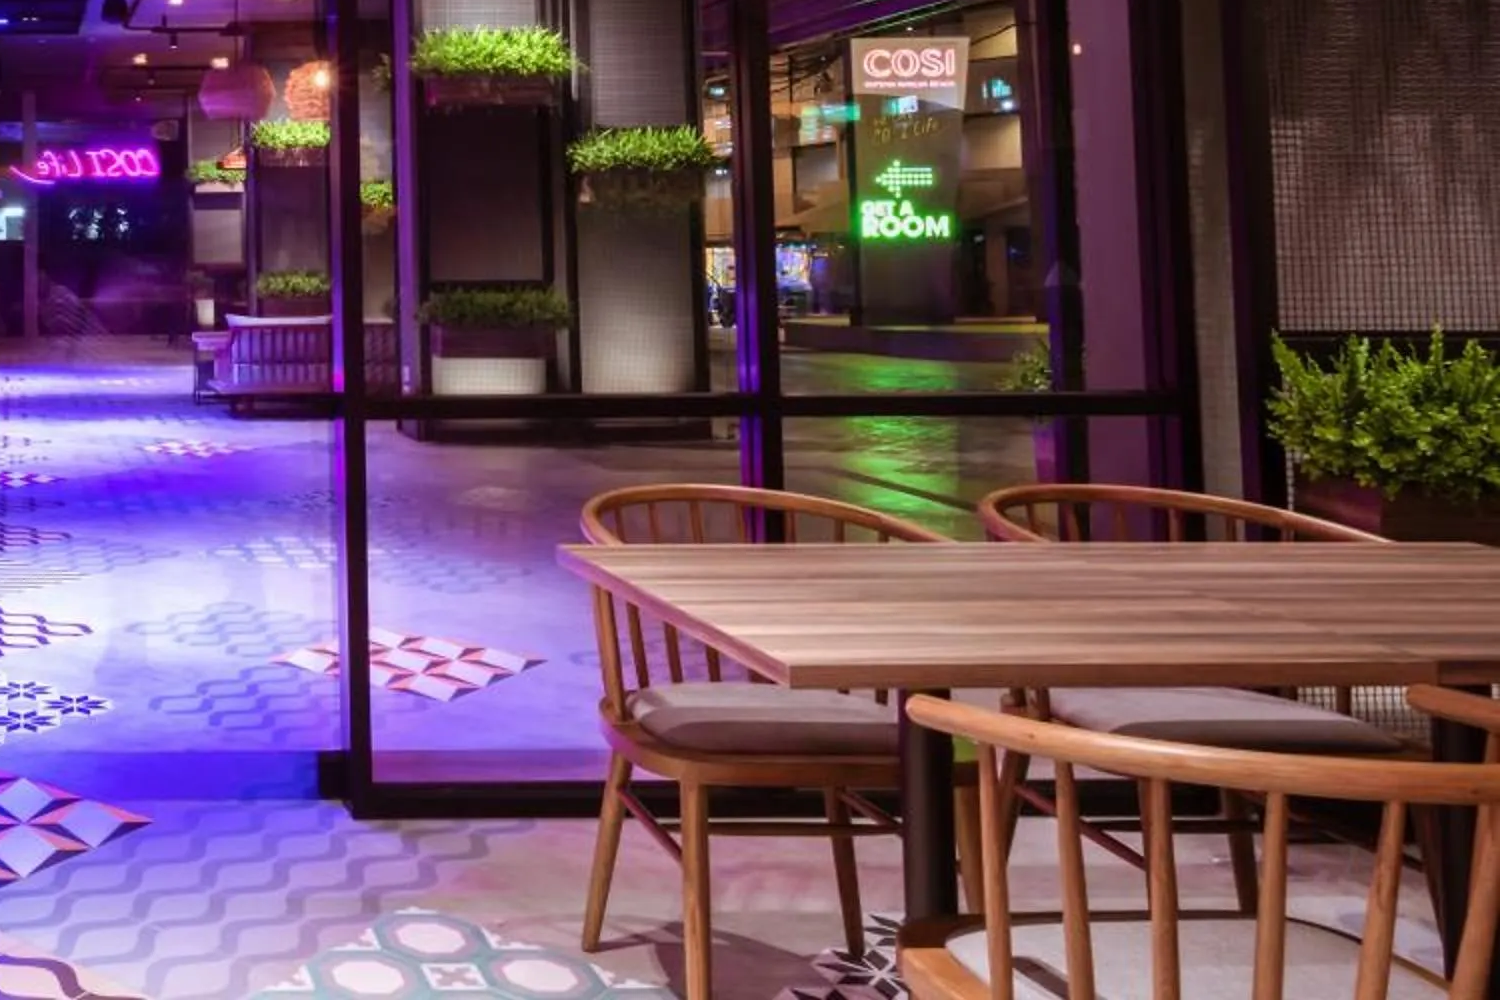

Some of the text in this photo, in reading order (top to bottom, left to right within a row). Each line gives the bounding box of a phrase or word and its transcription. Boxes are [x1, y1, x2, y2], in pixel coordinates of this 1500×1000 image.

[863, 48, 956, 78] COSI
[899, 200, 914, 216] A
[862, 215, 950, 238] ROOM
